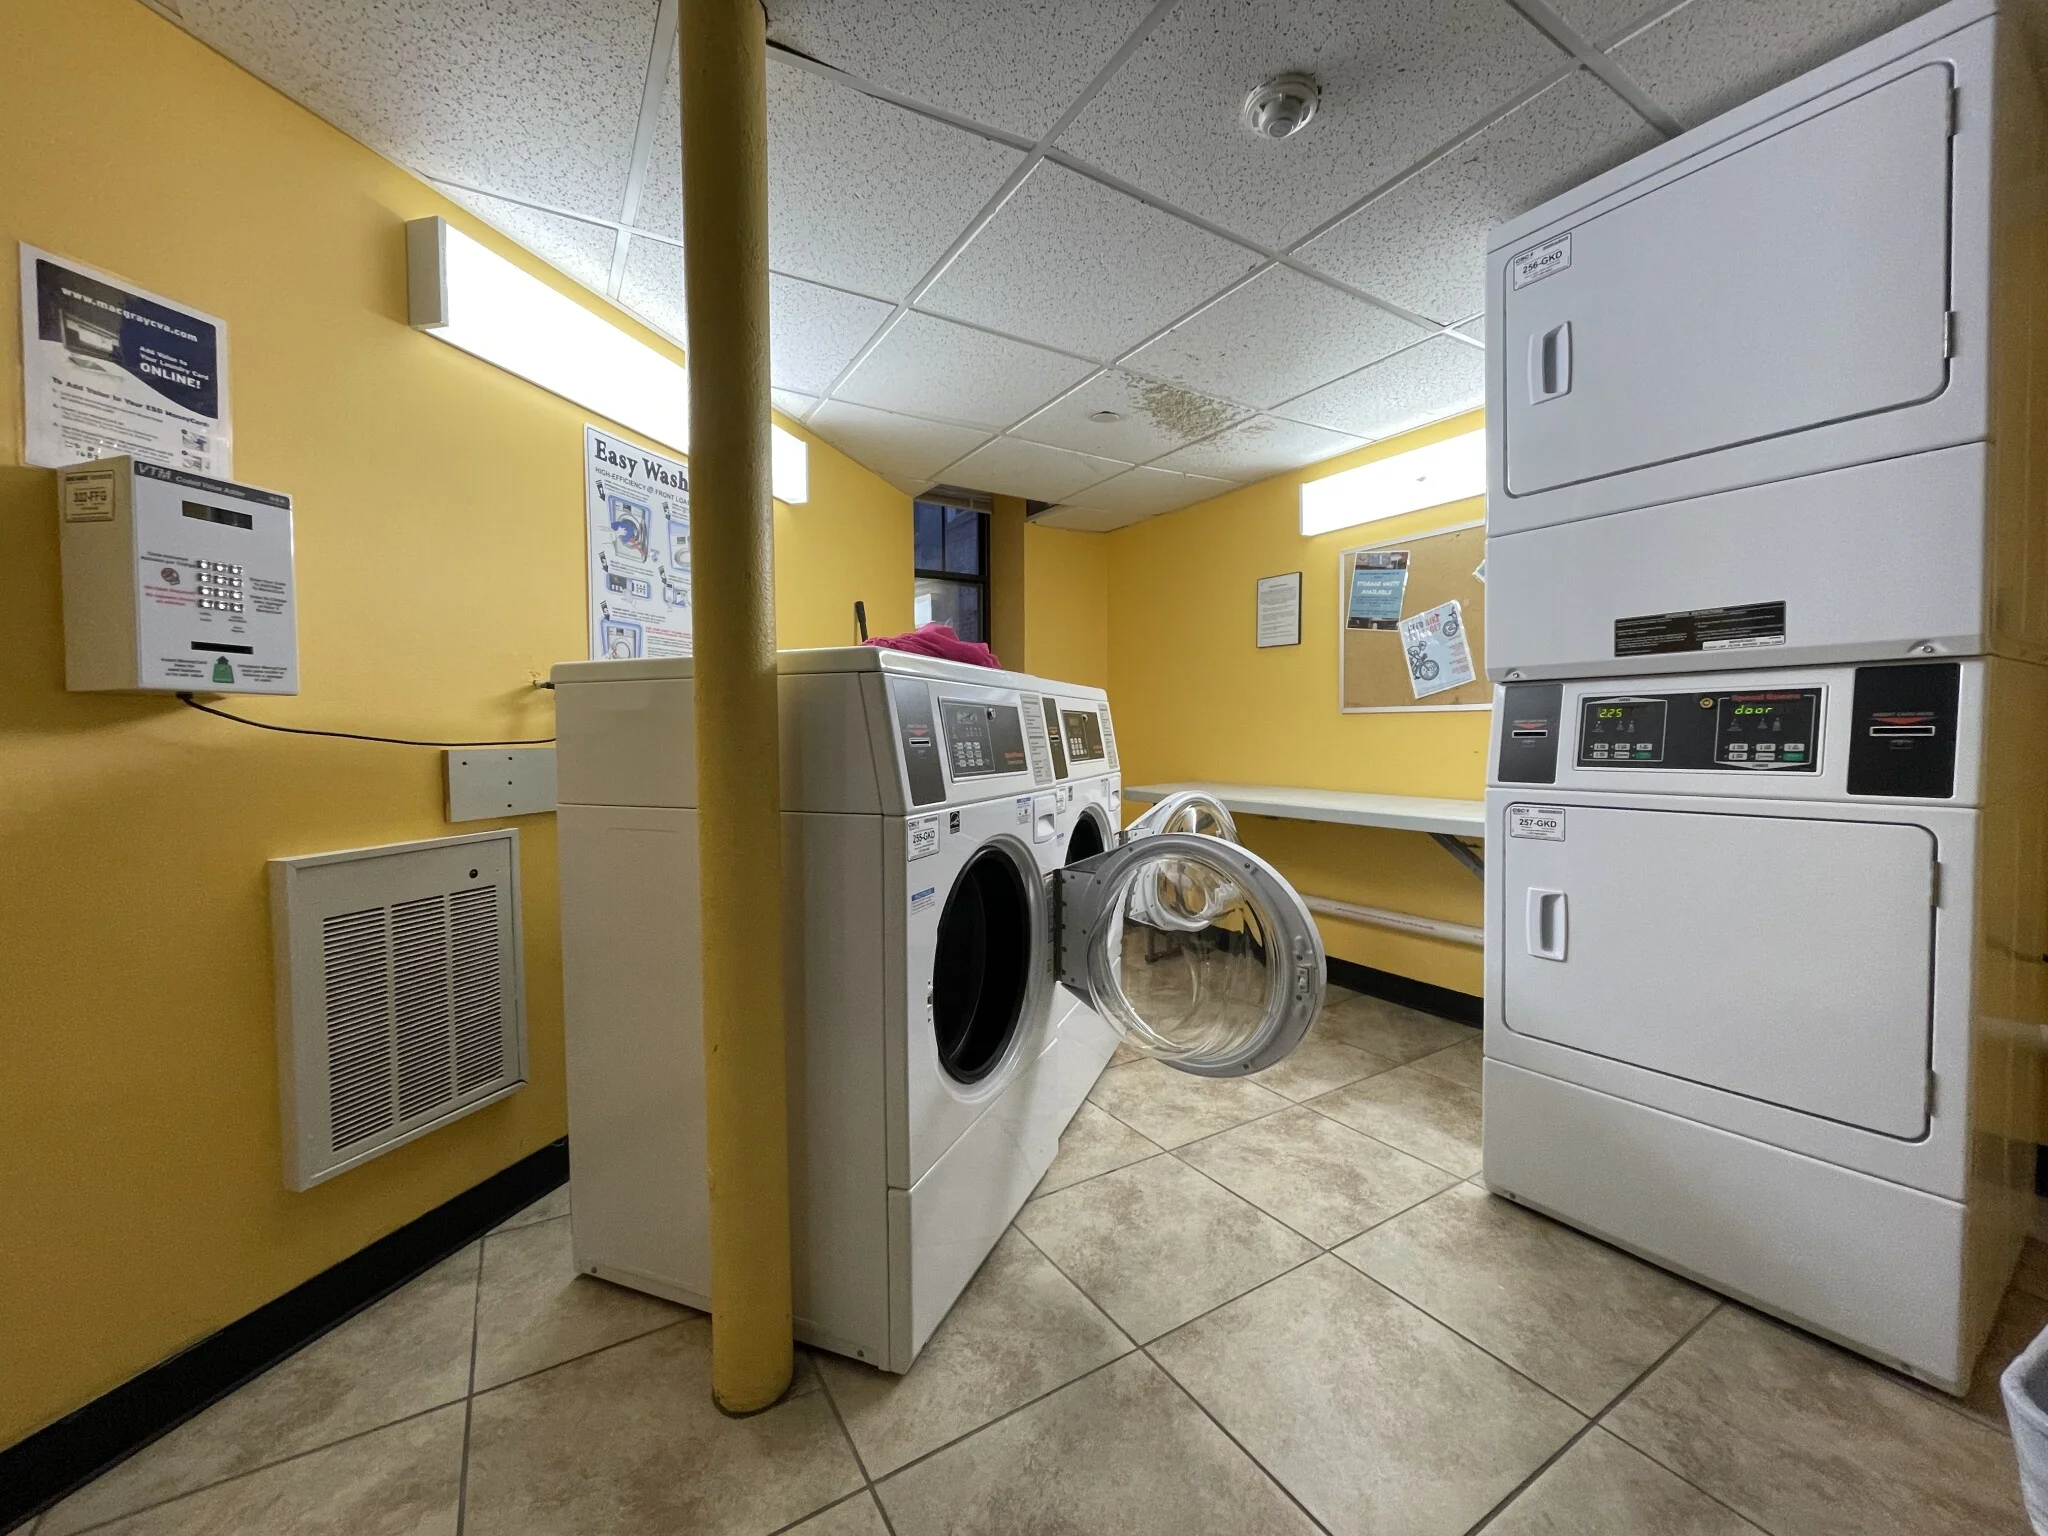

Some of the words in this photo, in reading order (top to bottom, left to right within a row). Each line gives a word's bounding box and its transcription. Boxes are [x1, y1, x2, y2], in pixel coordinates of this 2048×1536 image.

[1523, 250, 1562, 273] 256-GKD
[60, 287, 198, 342] www.macgraycva.com
[139, 362, 201, 389] ONLINE!
[191, 370, 209, 381] Card
[124, 398, 143, 409] Your
[138, 463, 172, 481] VTM
[595, 438, 638, 478] Easy
[641, 457, 689, 493] Wash
[595, 466, 647, 491] HIGH-EFFICIENCY
[655, 489, 674, 501] FRONT
[675, 496, 689, 505] LOA
[1734, 704, 1773, 715] door
[1519, 818, 1557, 828] 257-GKD
[912, 830, 936, 844] 255-GKD
